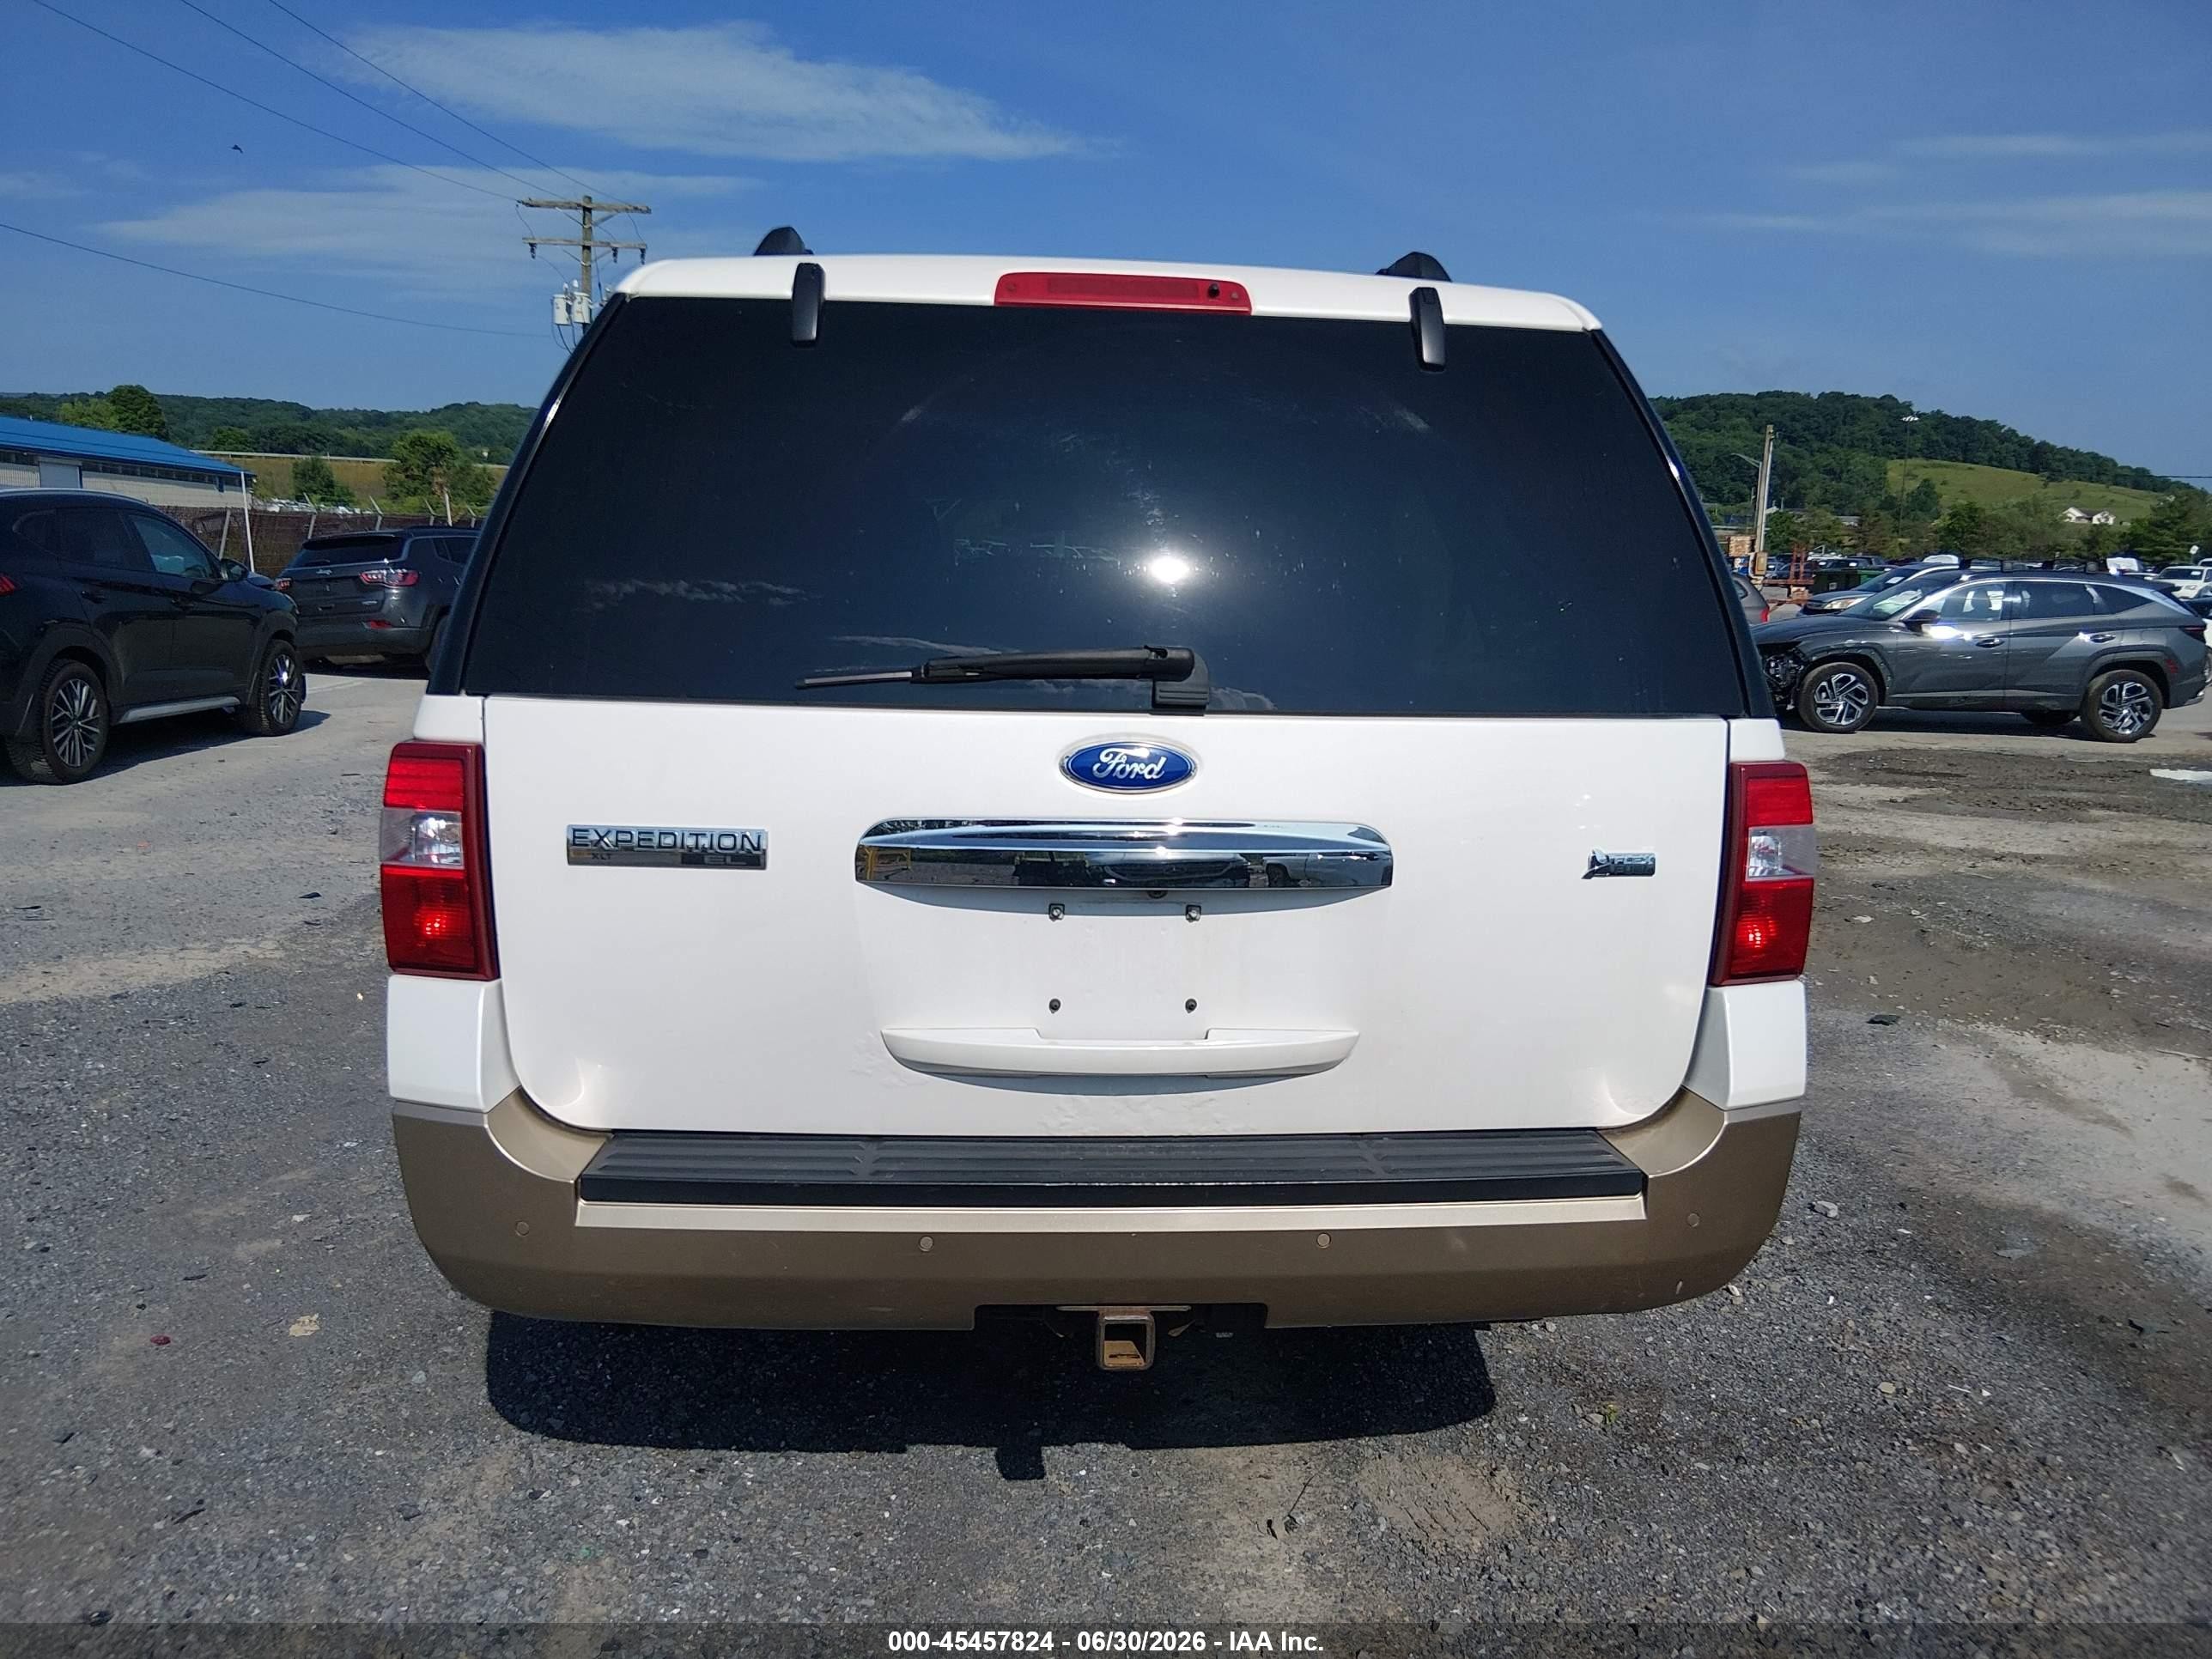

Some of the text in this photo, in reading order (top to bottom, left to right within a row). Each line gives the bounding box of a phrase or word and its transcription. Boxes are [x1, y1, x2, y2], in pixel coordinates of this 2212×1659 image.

[1092, 747, 1168, 780] Ford
[572, 828, 764, 854] EXPEDITION
[591, 852, 612, 860] XLT
